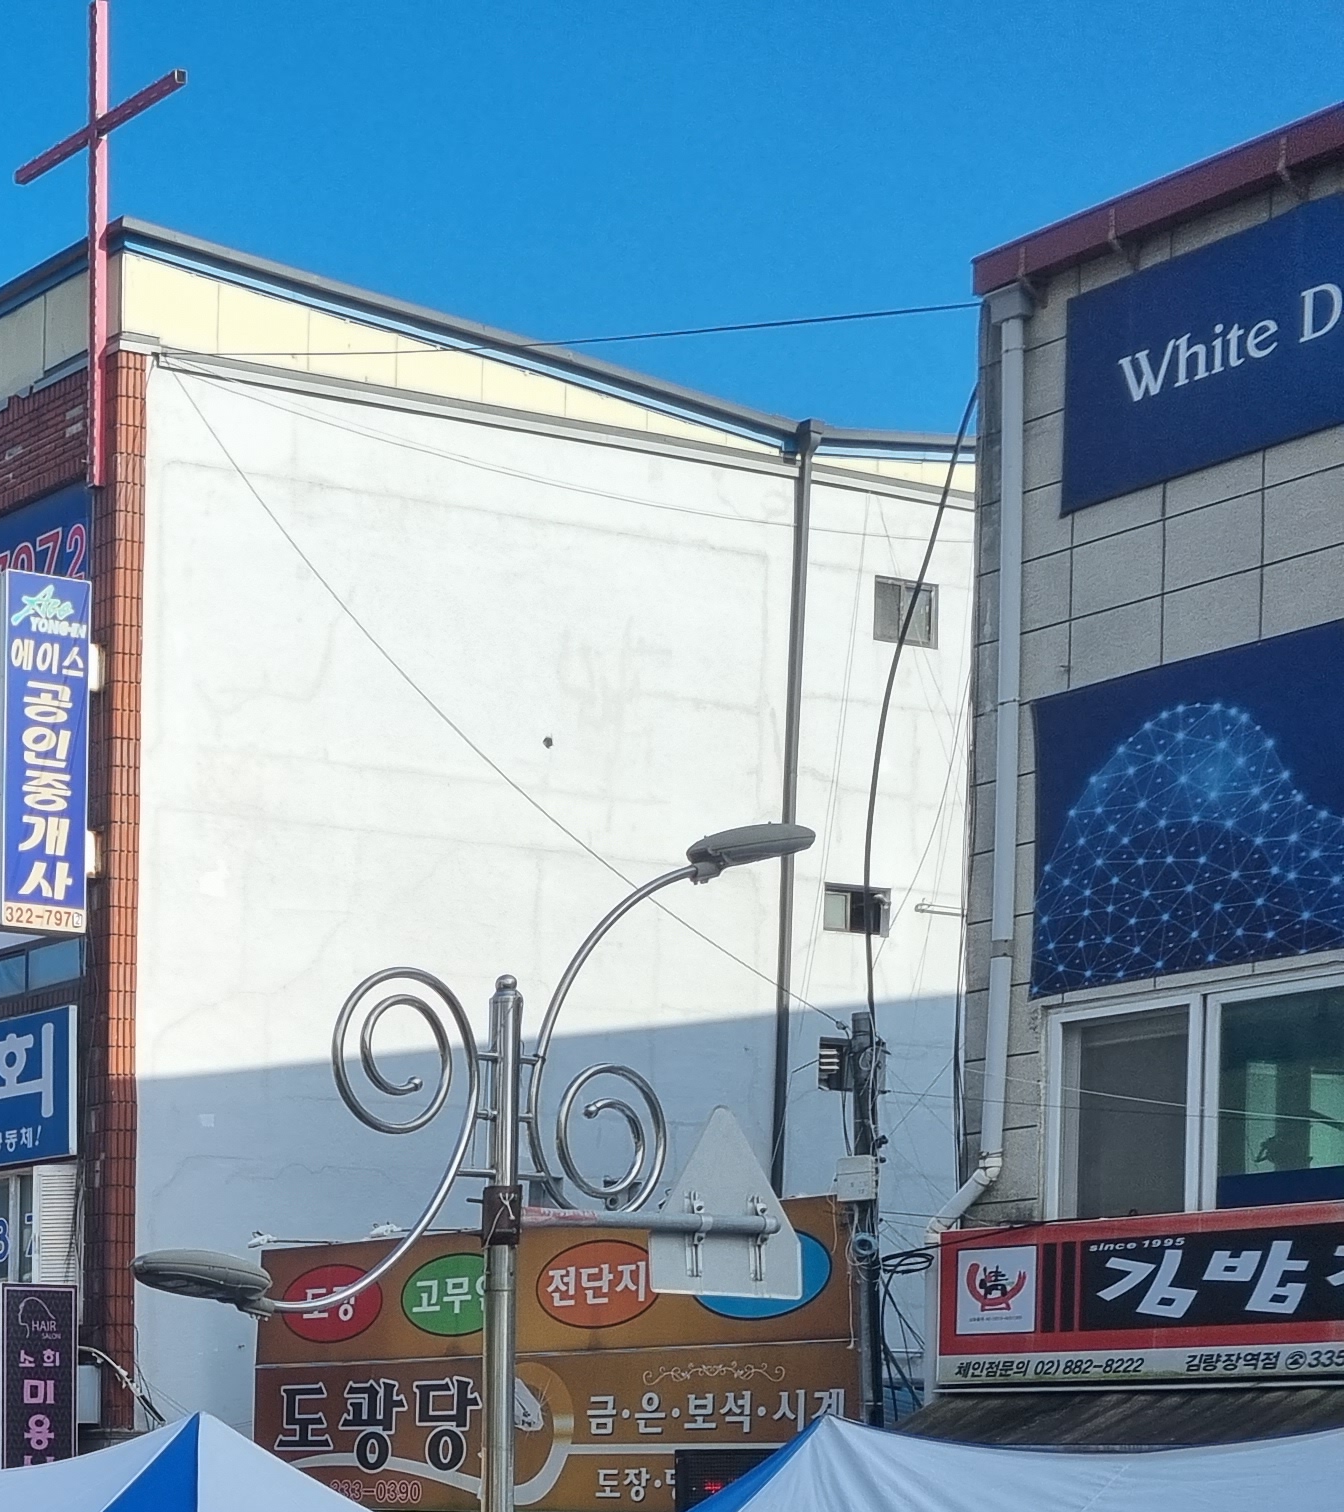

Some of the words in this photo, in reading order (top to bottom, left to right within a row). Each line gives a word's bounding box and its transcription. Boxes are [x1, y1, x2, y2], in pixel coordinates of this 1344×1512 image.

[1118, 318, 1279, 402] White
[11, 638, 85, 677] 에이스
[18, 681, 72, 900] 공인중개사
[5, 907, 83, 930] 322-7972
[1088, 1238, 1138, 1253] since
[1141, 1235, 1186, 1249] 1995
[545, 1264, 649, 1307] 전단지
[1096, 1239, 1344, 1320] 김밥
[32, 1319, 58, 1333] HAIR
[19, 1348, 61, 1367] 소희
[954, 1359, 1029, 1380] 체인점문의
[1185, 1349, 1281, 1373] 김량장역점
[274, 1375, 483, 1474] 도광당
